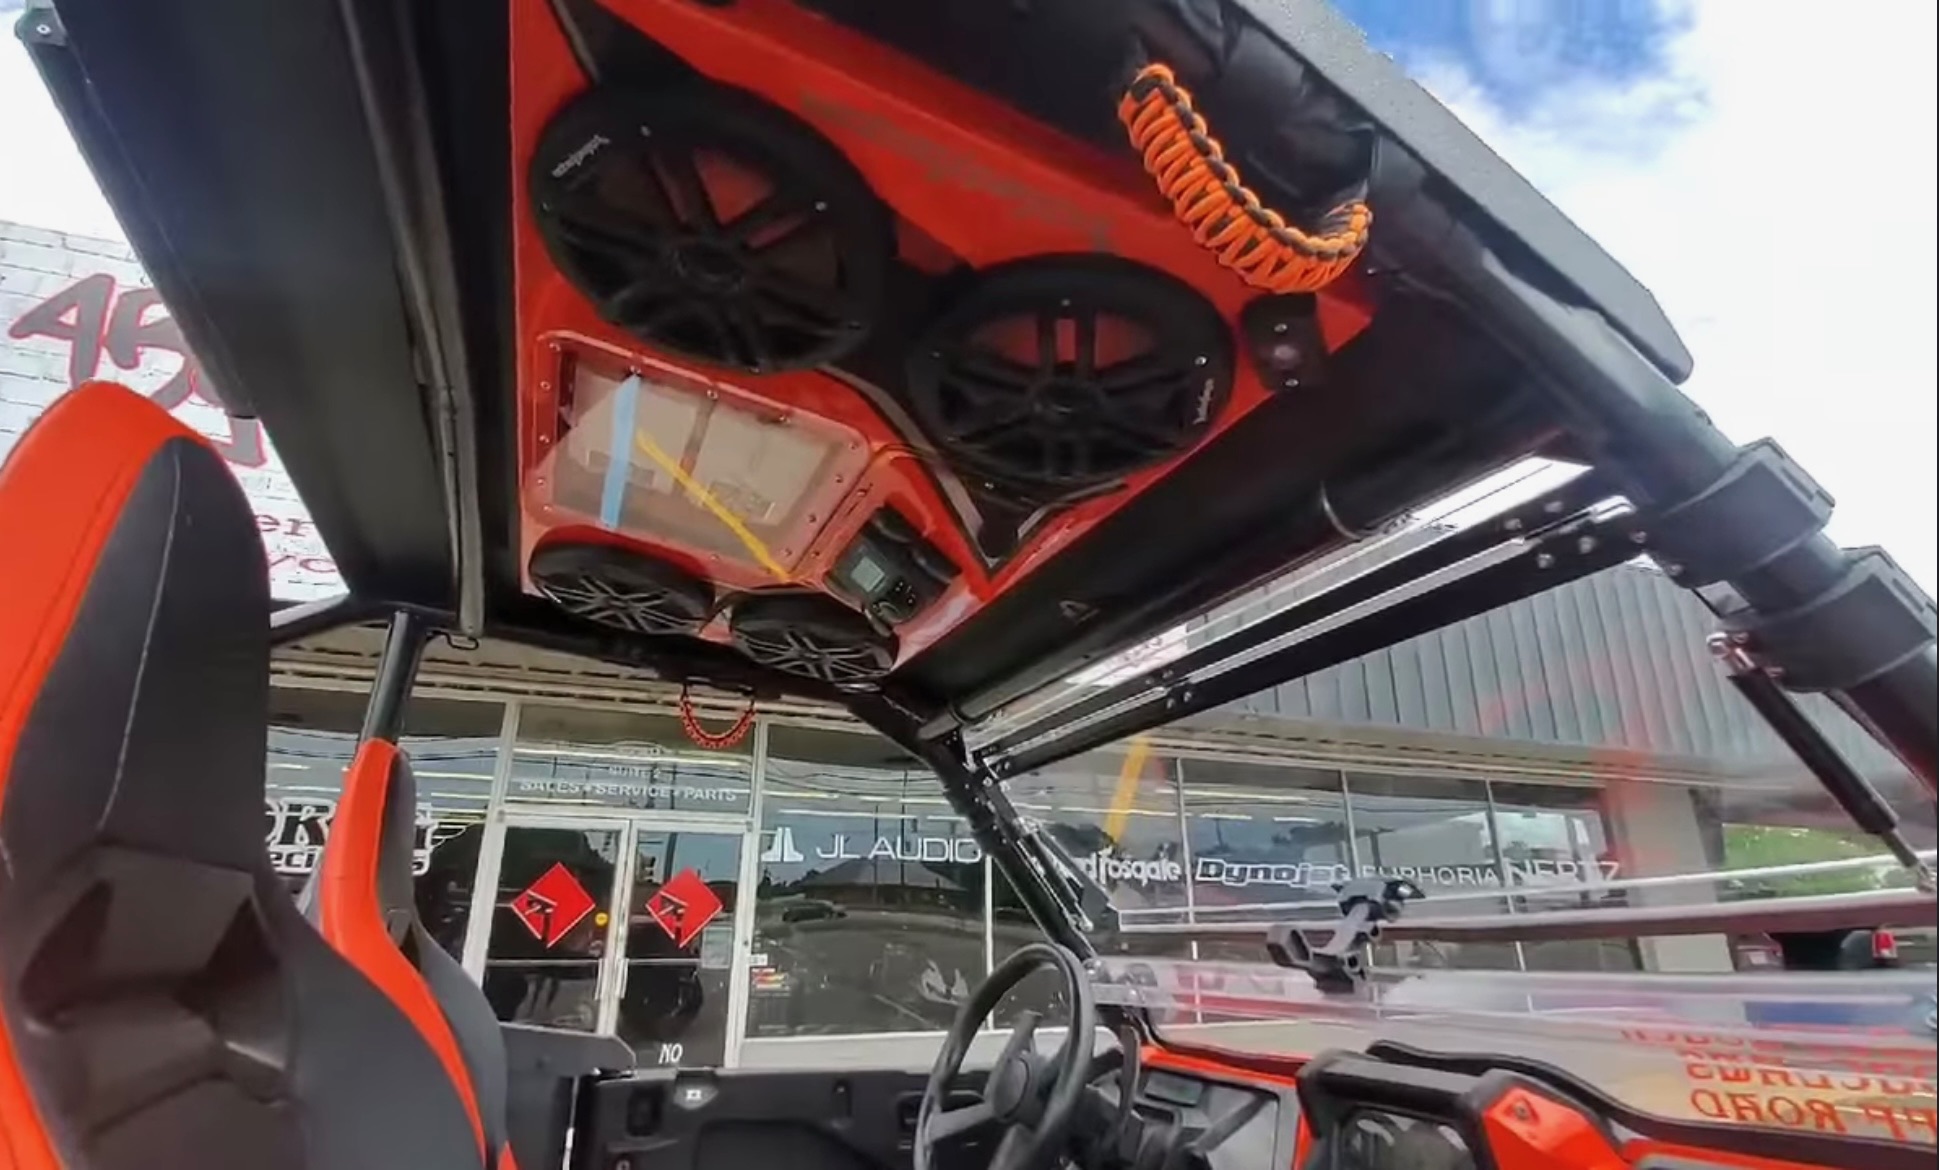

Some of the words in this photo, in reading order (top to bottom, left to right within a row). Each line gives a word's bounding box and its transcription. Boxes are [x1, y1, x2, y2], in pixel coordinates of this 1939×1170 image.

[519, 780, 581, 793] SALES
[595, 783, 673, 799] SERVICE
[683, 787, 737, 802] PARTS
[815, 834, 861, 860] JL
[867, 835, 982, 863] AUDIO
[657, 1042, 684, 1065] NO
